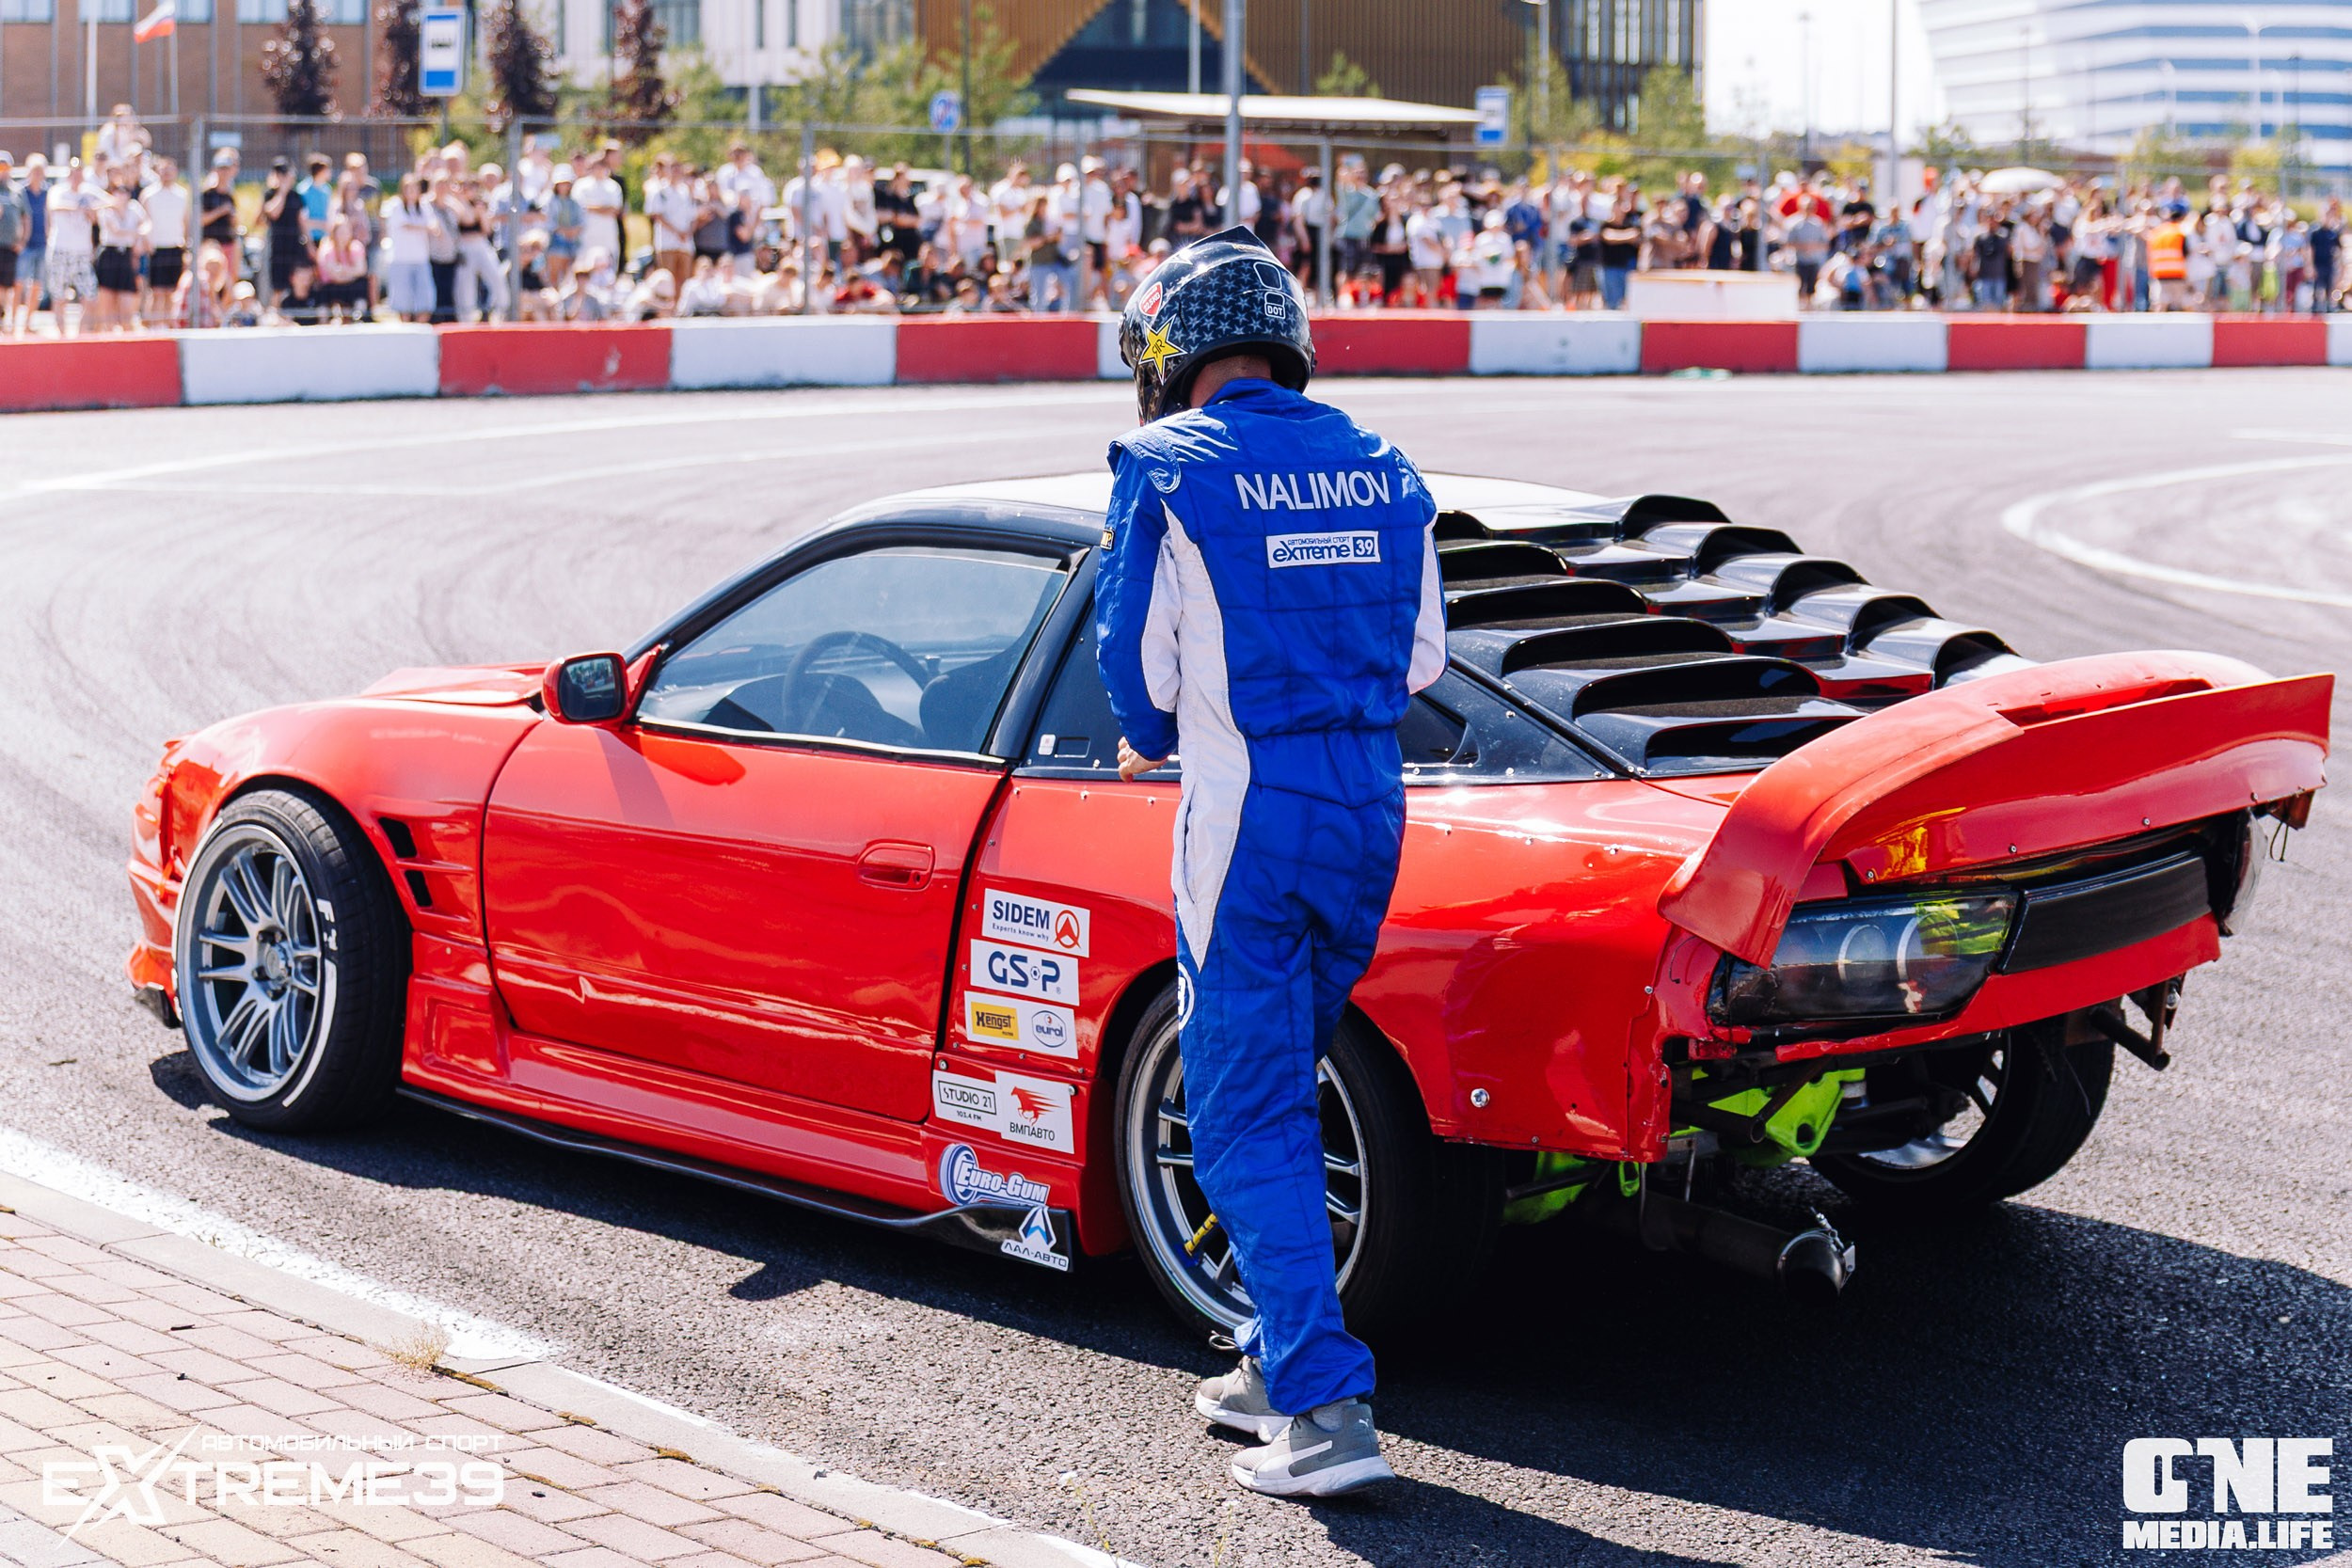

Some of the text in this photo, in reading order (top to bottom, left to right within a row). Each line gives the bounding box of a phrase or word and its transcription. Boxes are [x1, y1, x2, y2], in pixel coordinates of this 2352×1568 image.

[1267, 305, 1283, 316] DOT
[1234, 471, 1391, 510] NALIMOV
[1356, 539, 1374, 556] 39
[993, 899, 1050, 930] SIDEM
[993, 923, 1049, 942] Experts know why
[1036, 1024, 1063, 1037] eurol
[943, 1087, 992, 1108] STUDIO 21
[973, 1113, 982, 1121] FM
[1009, 1121, 1056, 1141] ВМПАВТО
